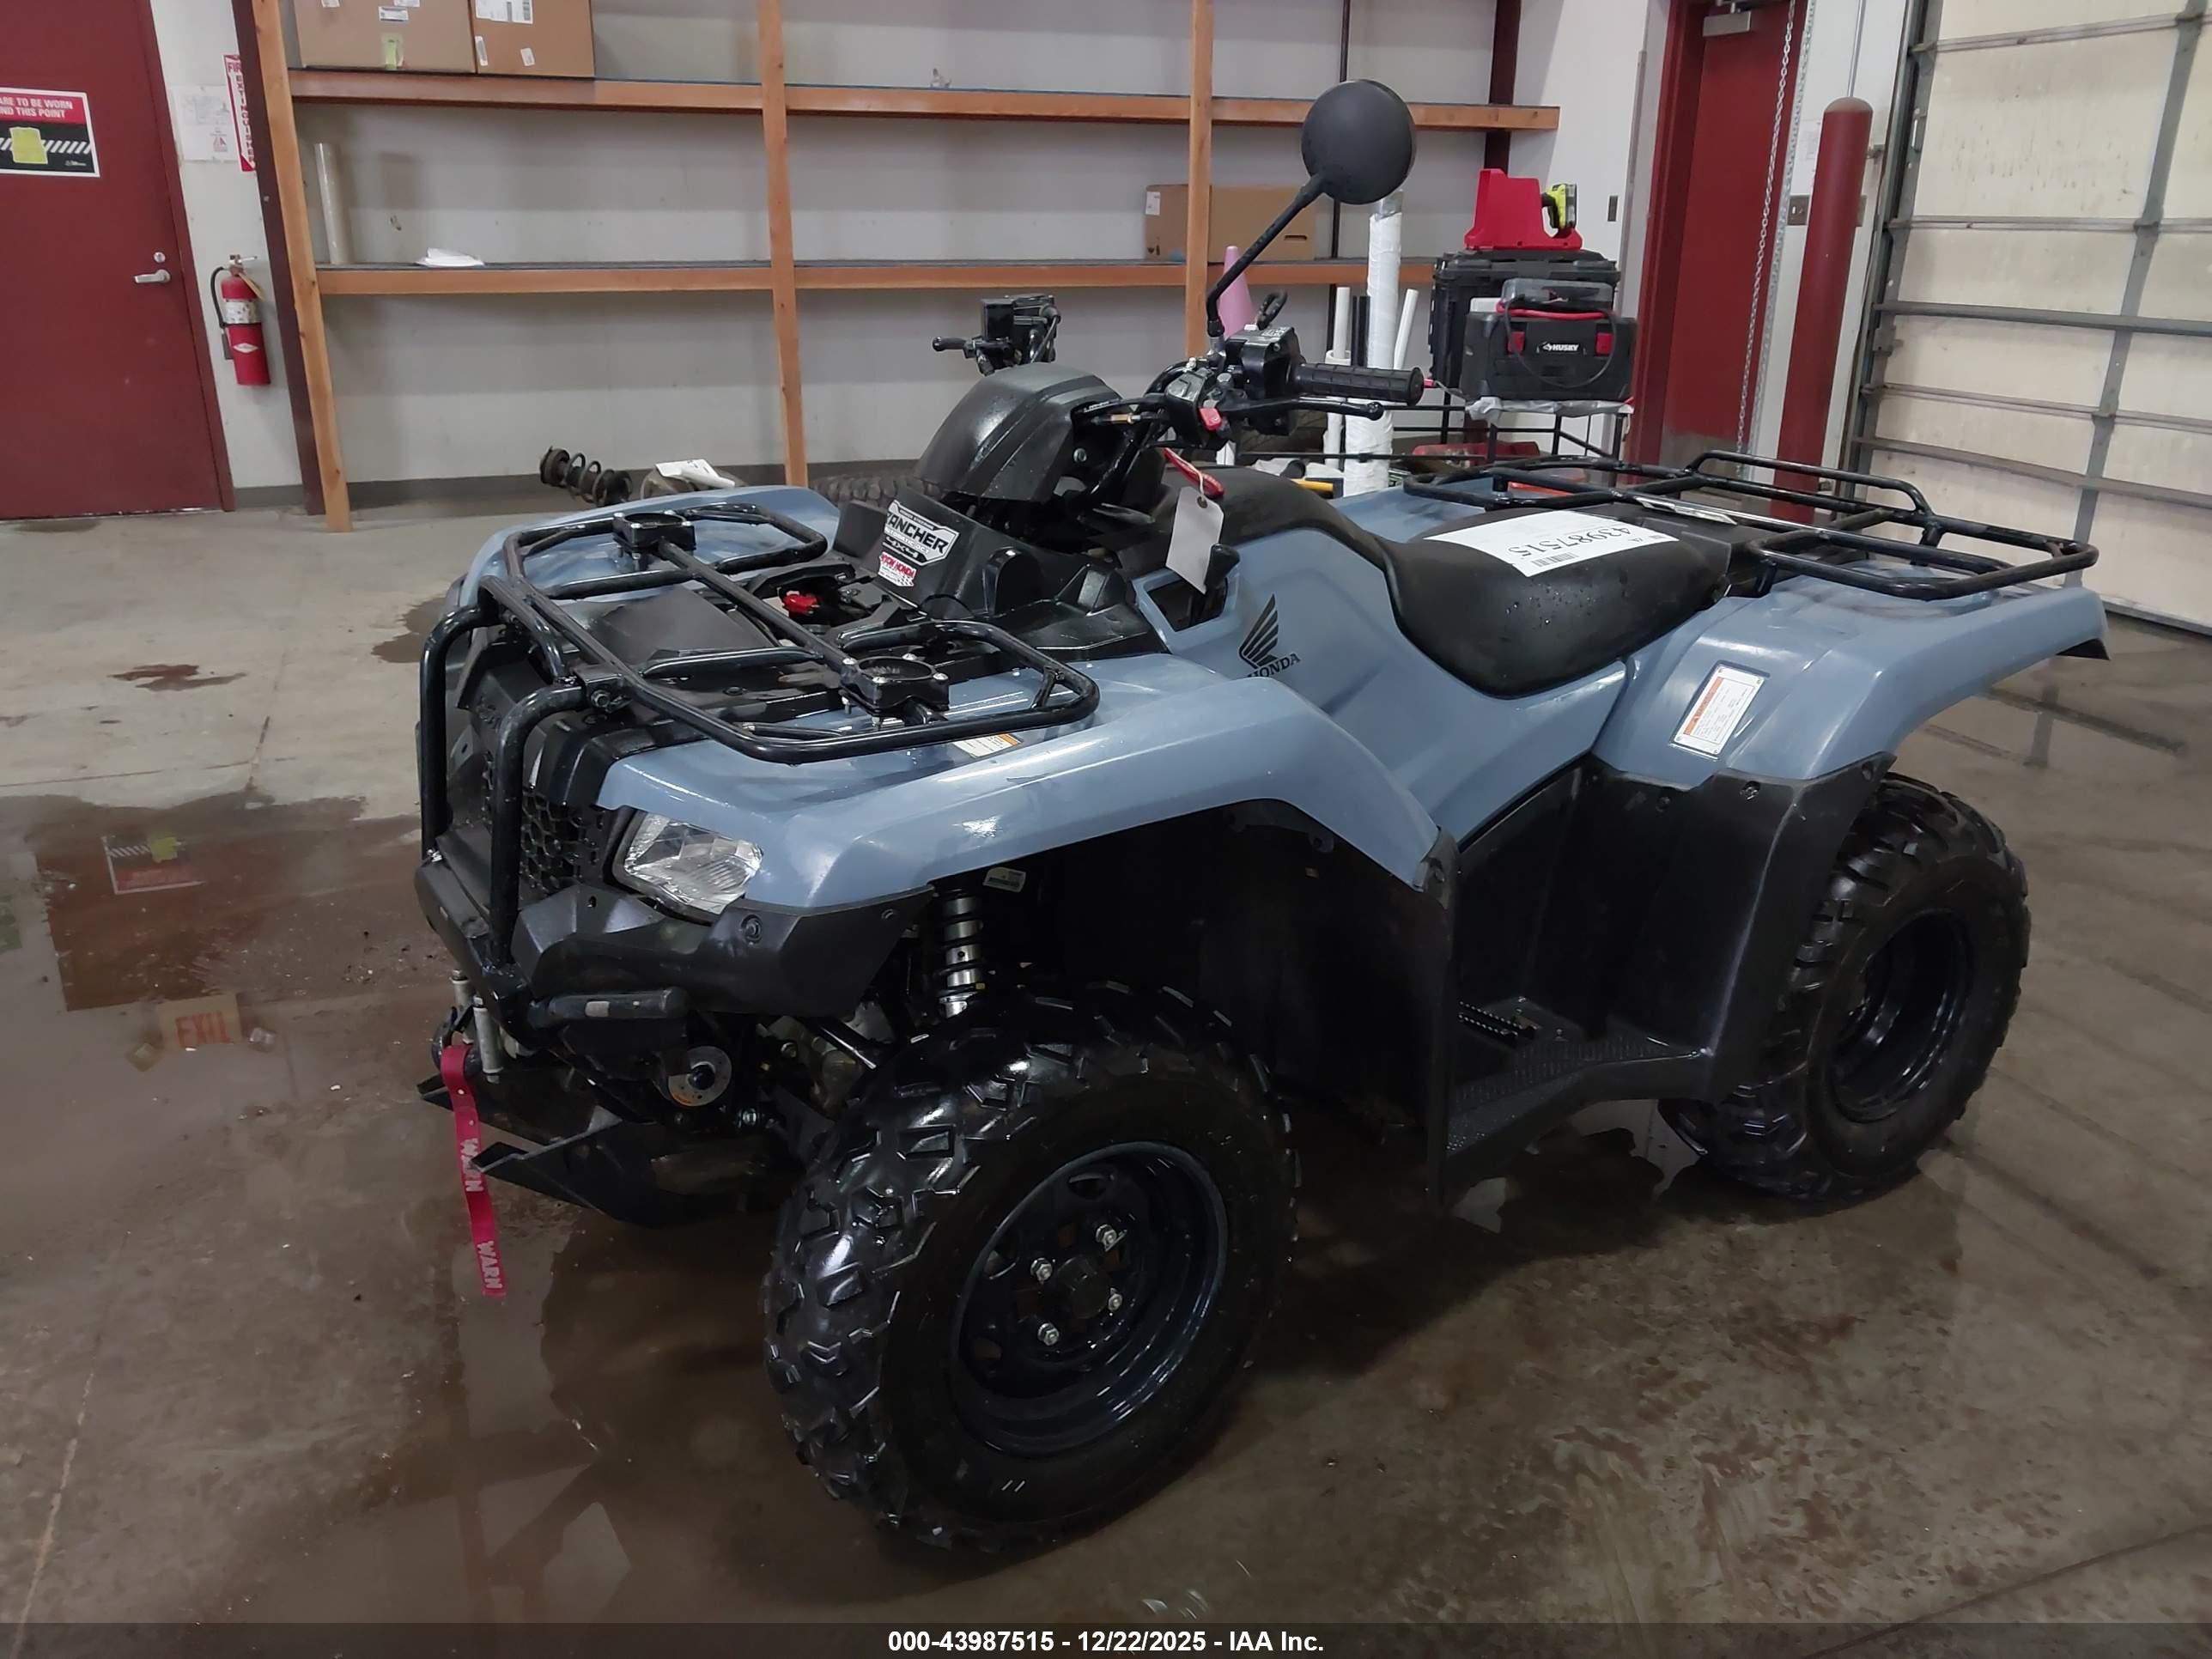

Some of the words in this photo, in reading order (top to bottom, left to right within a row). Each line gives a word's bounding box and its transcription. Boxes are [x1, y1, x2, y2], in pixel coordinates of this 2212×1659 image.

[227, 61, 241, 74] FIR
[16, 97, 28, 106] TO
[31, 99, 42, 108] BE
[44, 100, 73, 110] WORN
[15, 107, 37, 117] THIS
[39, 109, 66, 118] POINT
[1508, 526, 1632, 556] 43987515
[477, 1240, 503, 1290] WARN
